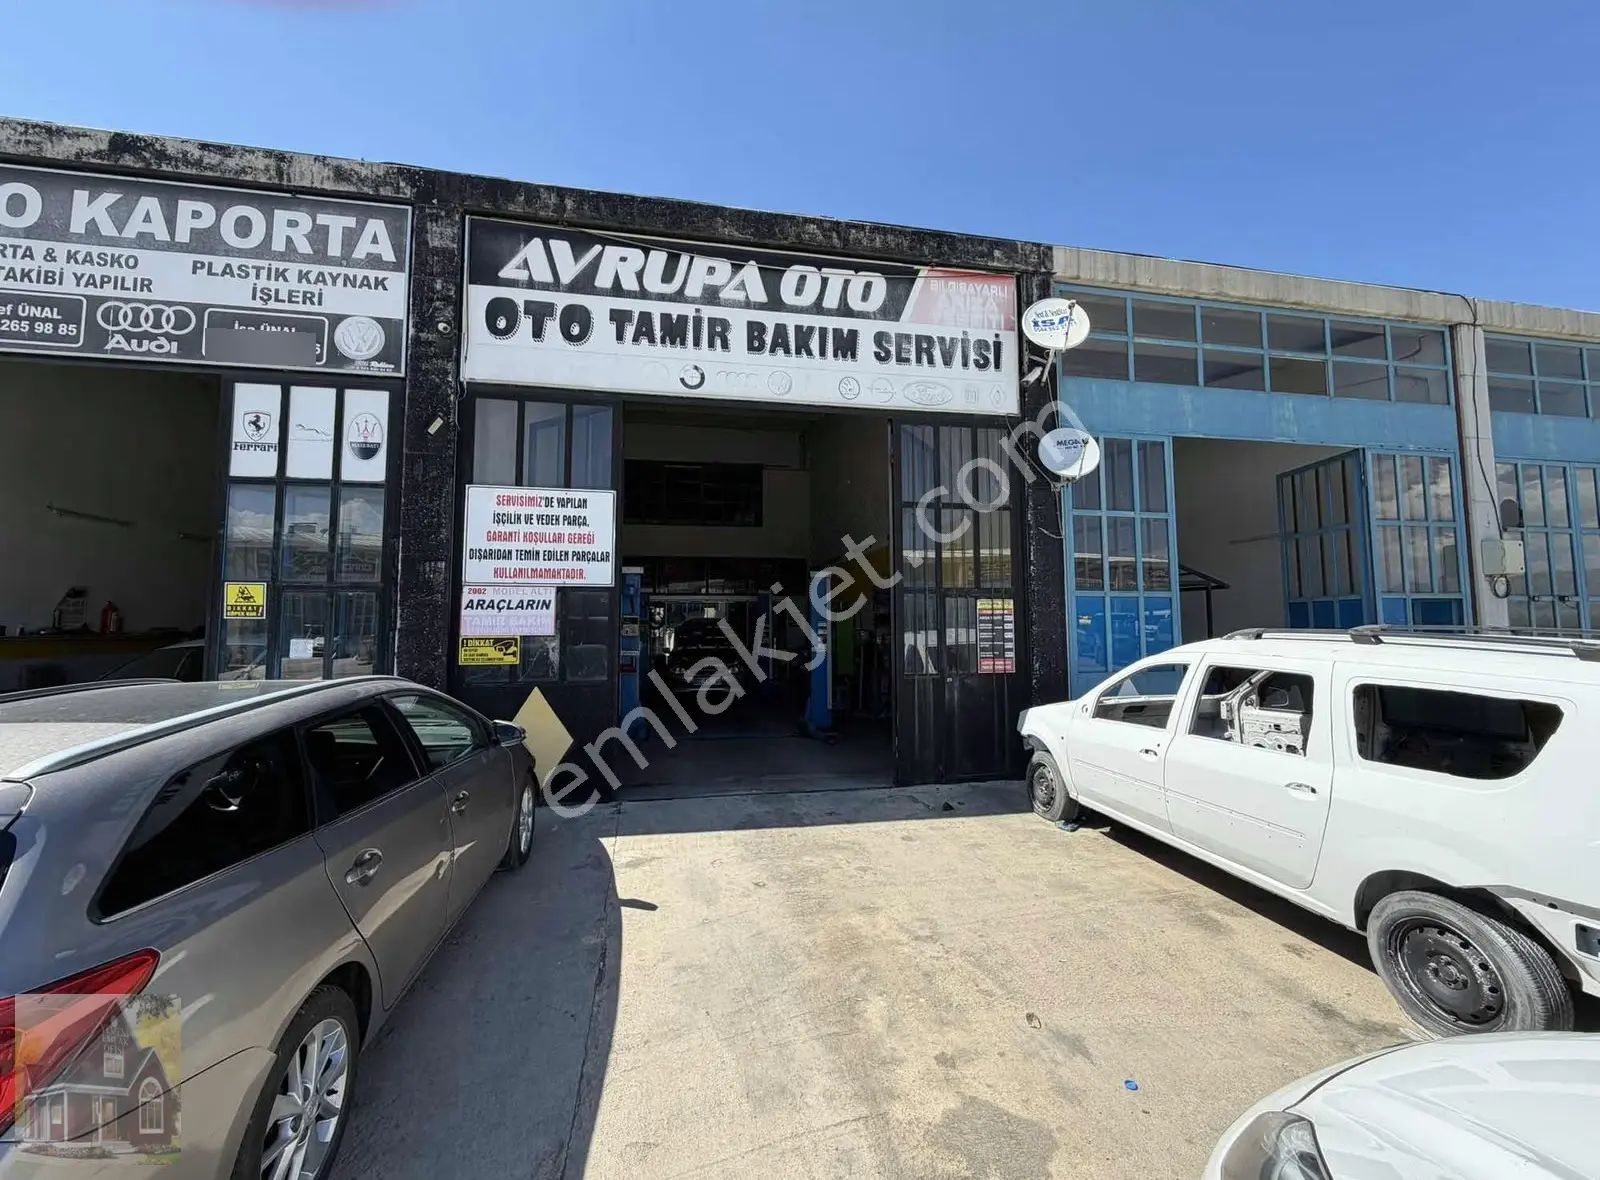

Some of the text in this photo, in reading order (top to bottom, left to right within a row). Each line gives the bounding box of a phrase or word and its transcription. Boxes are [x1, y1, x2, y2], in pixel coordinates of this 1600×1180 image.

[69, 189, 398, 263] KAPORTA
[43, 247, 58, 263] &
[66, 249, 139, 269] KASKO
[72, 272, 153, 293] YAPILIR
[191, 260, 389, 292] PLASTİK KAYNAK
[497, 237, 768, 303] AVRUPA
[780, 264, 887, 312] OTO
[251, 282, 324, 307] İŞLERİ
[18, 301, 62, 319] ÜNAL
[0, 319, 77, 337] 265 98 85
[485, 296, 1004, 373] OTO TAMİR BAKIM SERVİSİ
[103, 333, 178, 355] Audi
[233, 441, 278, 452] Ferrari
[556, 497, 588, 510] YAPILAN
[493, 510, 521, 527] İŞÇİLİK
[524, 513, 535, 526] VE
[536, 513, 561, 526] YEDEK
[486, 528, 595, 545] GARANTİ KOŞULLARI GEREĞİ
[468, 547, 611, 565] DIŞARIDAN TEMİN EDİLEN PARÇALAR
[493, 566, 586, 581] KULLANILMAMAKTADIR.
[467, 587, 487, 595] 2002
[463, 599, 552, 614] ARAÇLARIN
